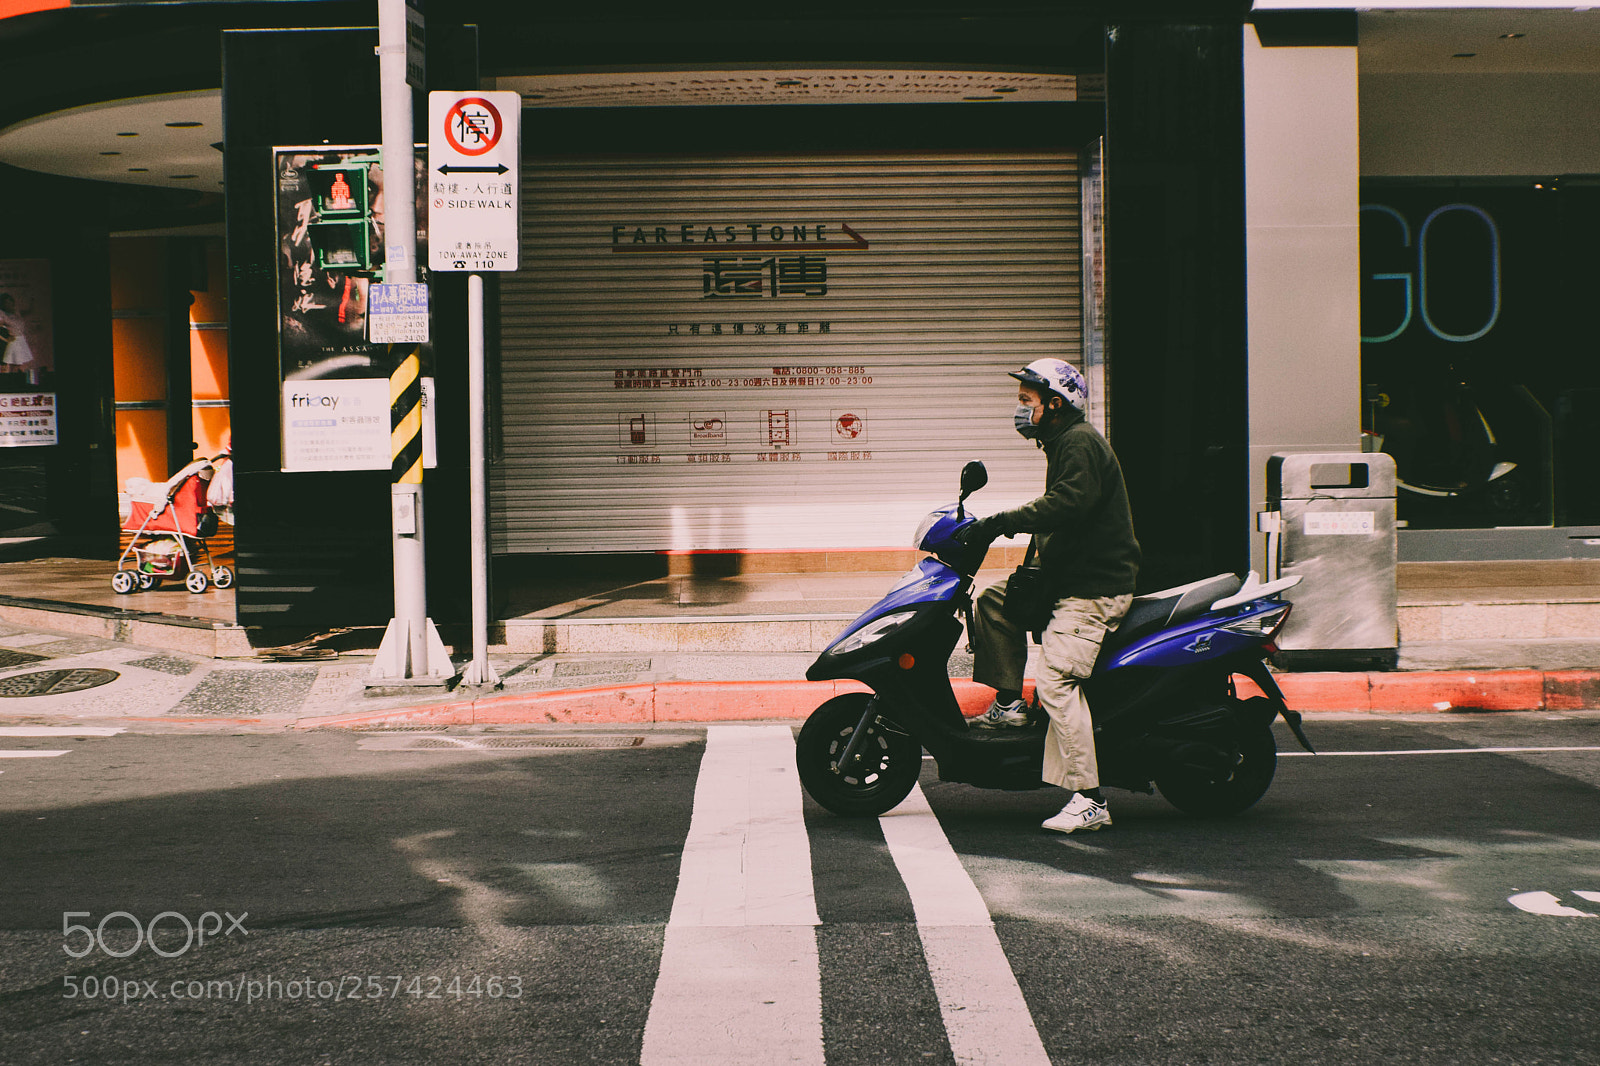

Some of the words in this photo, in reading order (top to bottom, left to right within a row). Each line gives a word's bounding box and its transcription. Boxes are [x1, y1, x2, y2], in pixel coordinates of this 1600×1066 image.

[457, 110, 489, 144] 停
[448, 199, 512, 209] SIDEWALK
[485, 251, 508, 259] ZONE
[474, 260, 494, 269] 110
